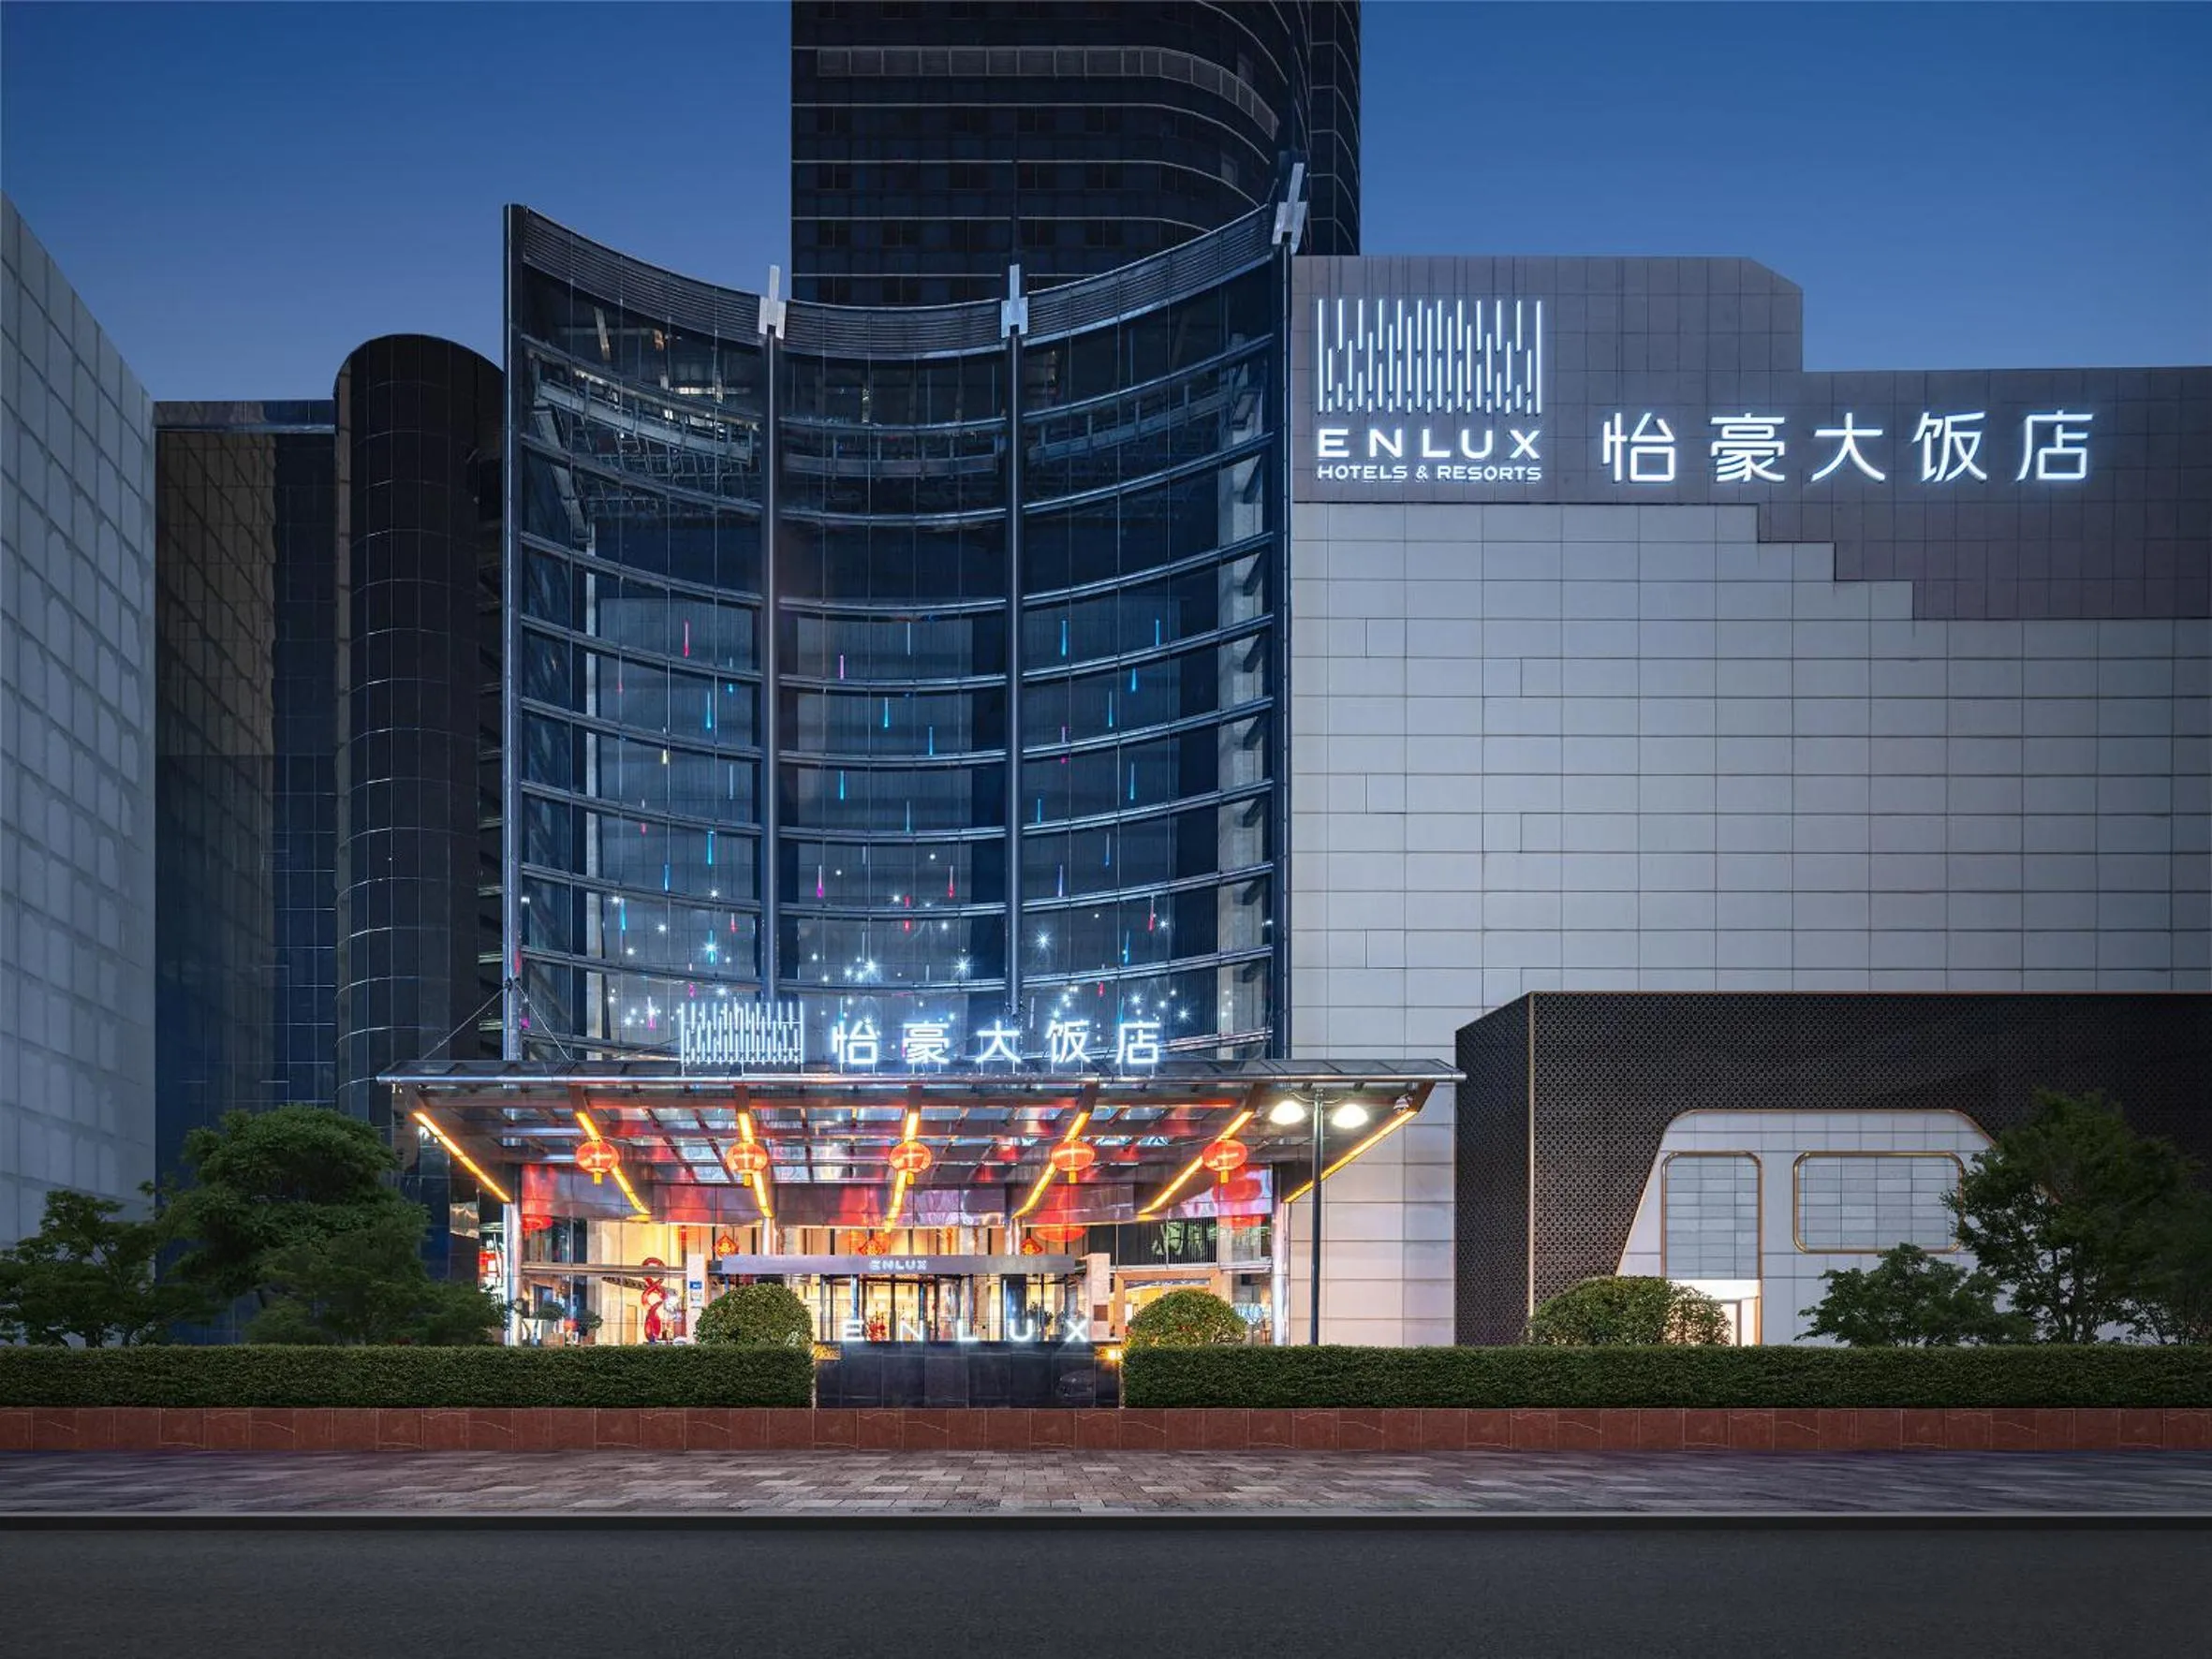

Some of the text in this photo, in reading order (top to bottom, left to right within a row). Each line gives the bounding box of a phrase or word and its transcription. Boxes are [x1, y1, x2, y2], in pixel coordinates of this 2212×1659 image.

[1318, 428, 1541, 459] ENLUX
[1603, 411, 2094, 482] 怡豪大饭店
[1318, 465, 1541, 481] HOTELS & RESORTS
[832, 1020, 1161, 1065] 怡豪大饭店
[869, 1259, 927, 1271] ENLUX
[842, 1318, 1089, 1342] ENLUX
